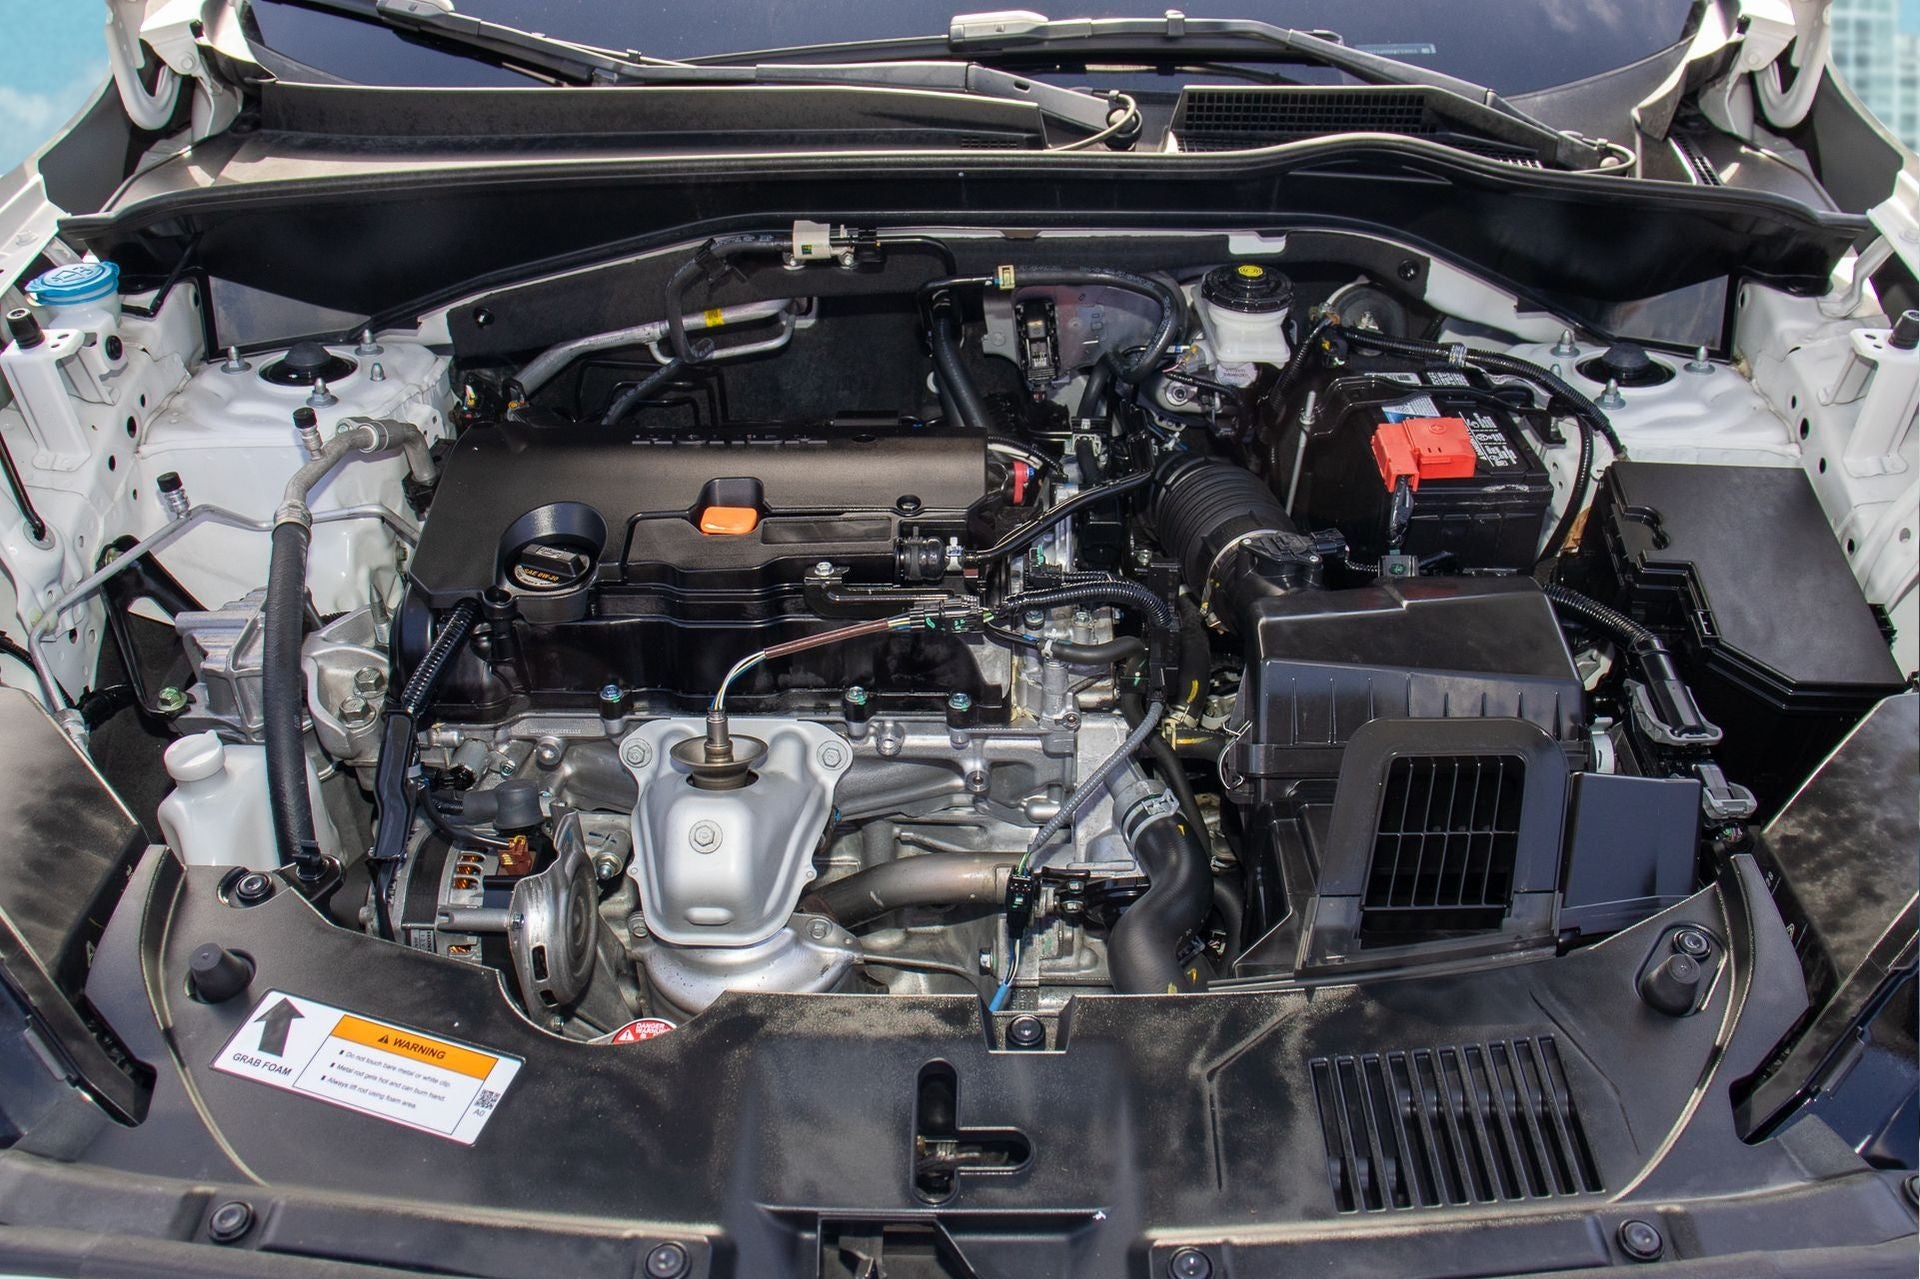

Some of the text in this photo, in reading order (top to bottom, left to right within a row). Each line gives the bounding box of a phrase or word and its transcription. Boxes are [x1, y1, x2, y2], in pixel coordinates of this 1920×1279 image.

[524, 568, 539, 578] SAE
[635, 1022, 666, 1030] DANGER
[394, 1038, 446, 1059] WARNING
[232, 1052, 292, 1076] GRAB FOAM
[345, 1051, 355, 1059] Do
[366, 1058, 382, 1067] touch
[398, 1067, 415, 1076] metal
[422, 1075, 439, 1084] white
[328, 1077, 349, 1089] Always
[368, 1090, 385, 1100] using
[386, 1095, 401, 1103] foam
[337, 1063, 354, 1073] Metal
[389, 1080, 402, 1088] and
[413, 1087, 428, 1095] burn
